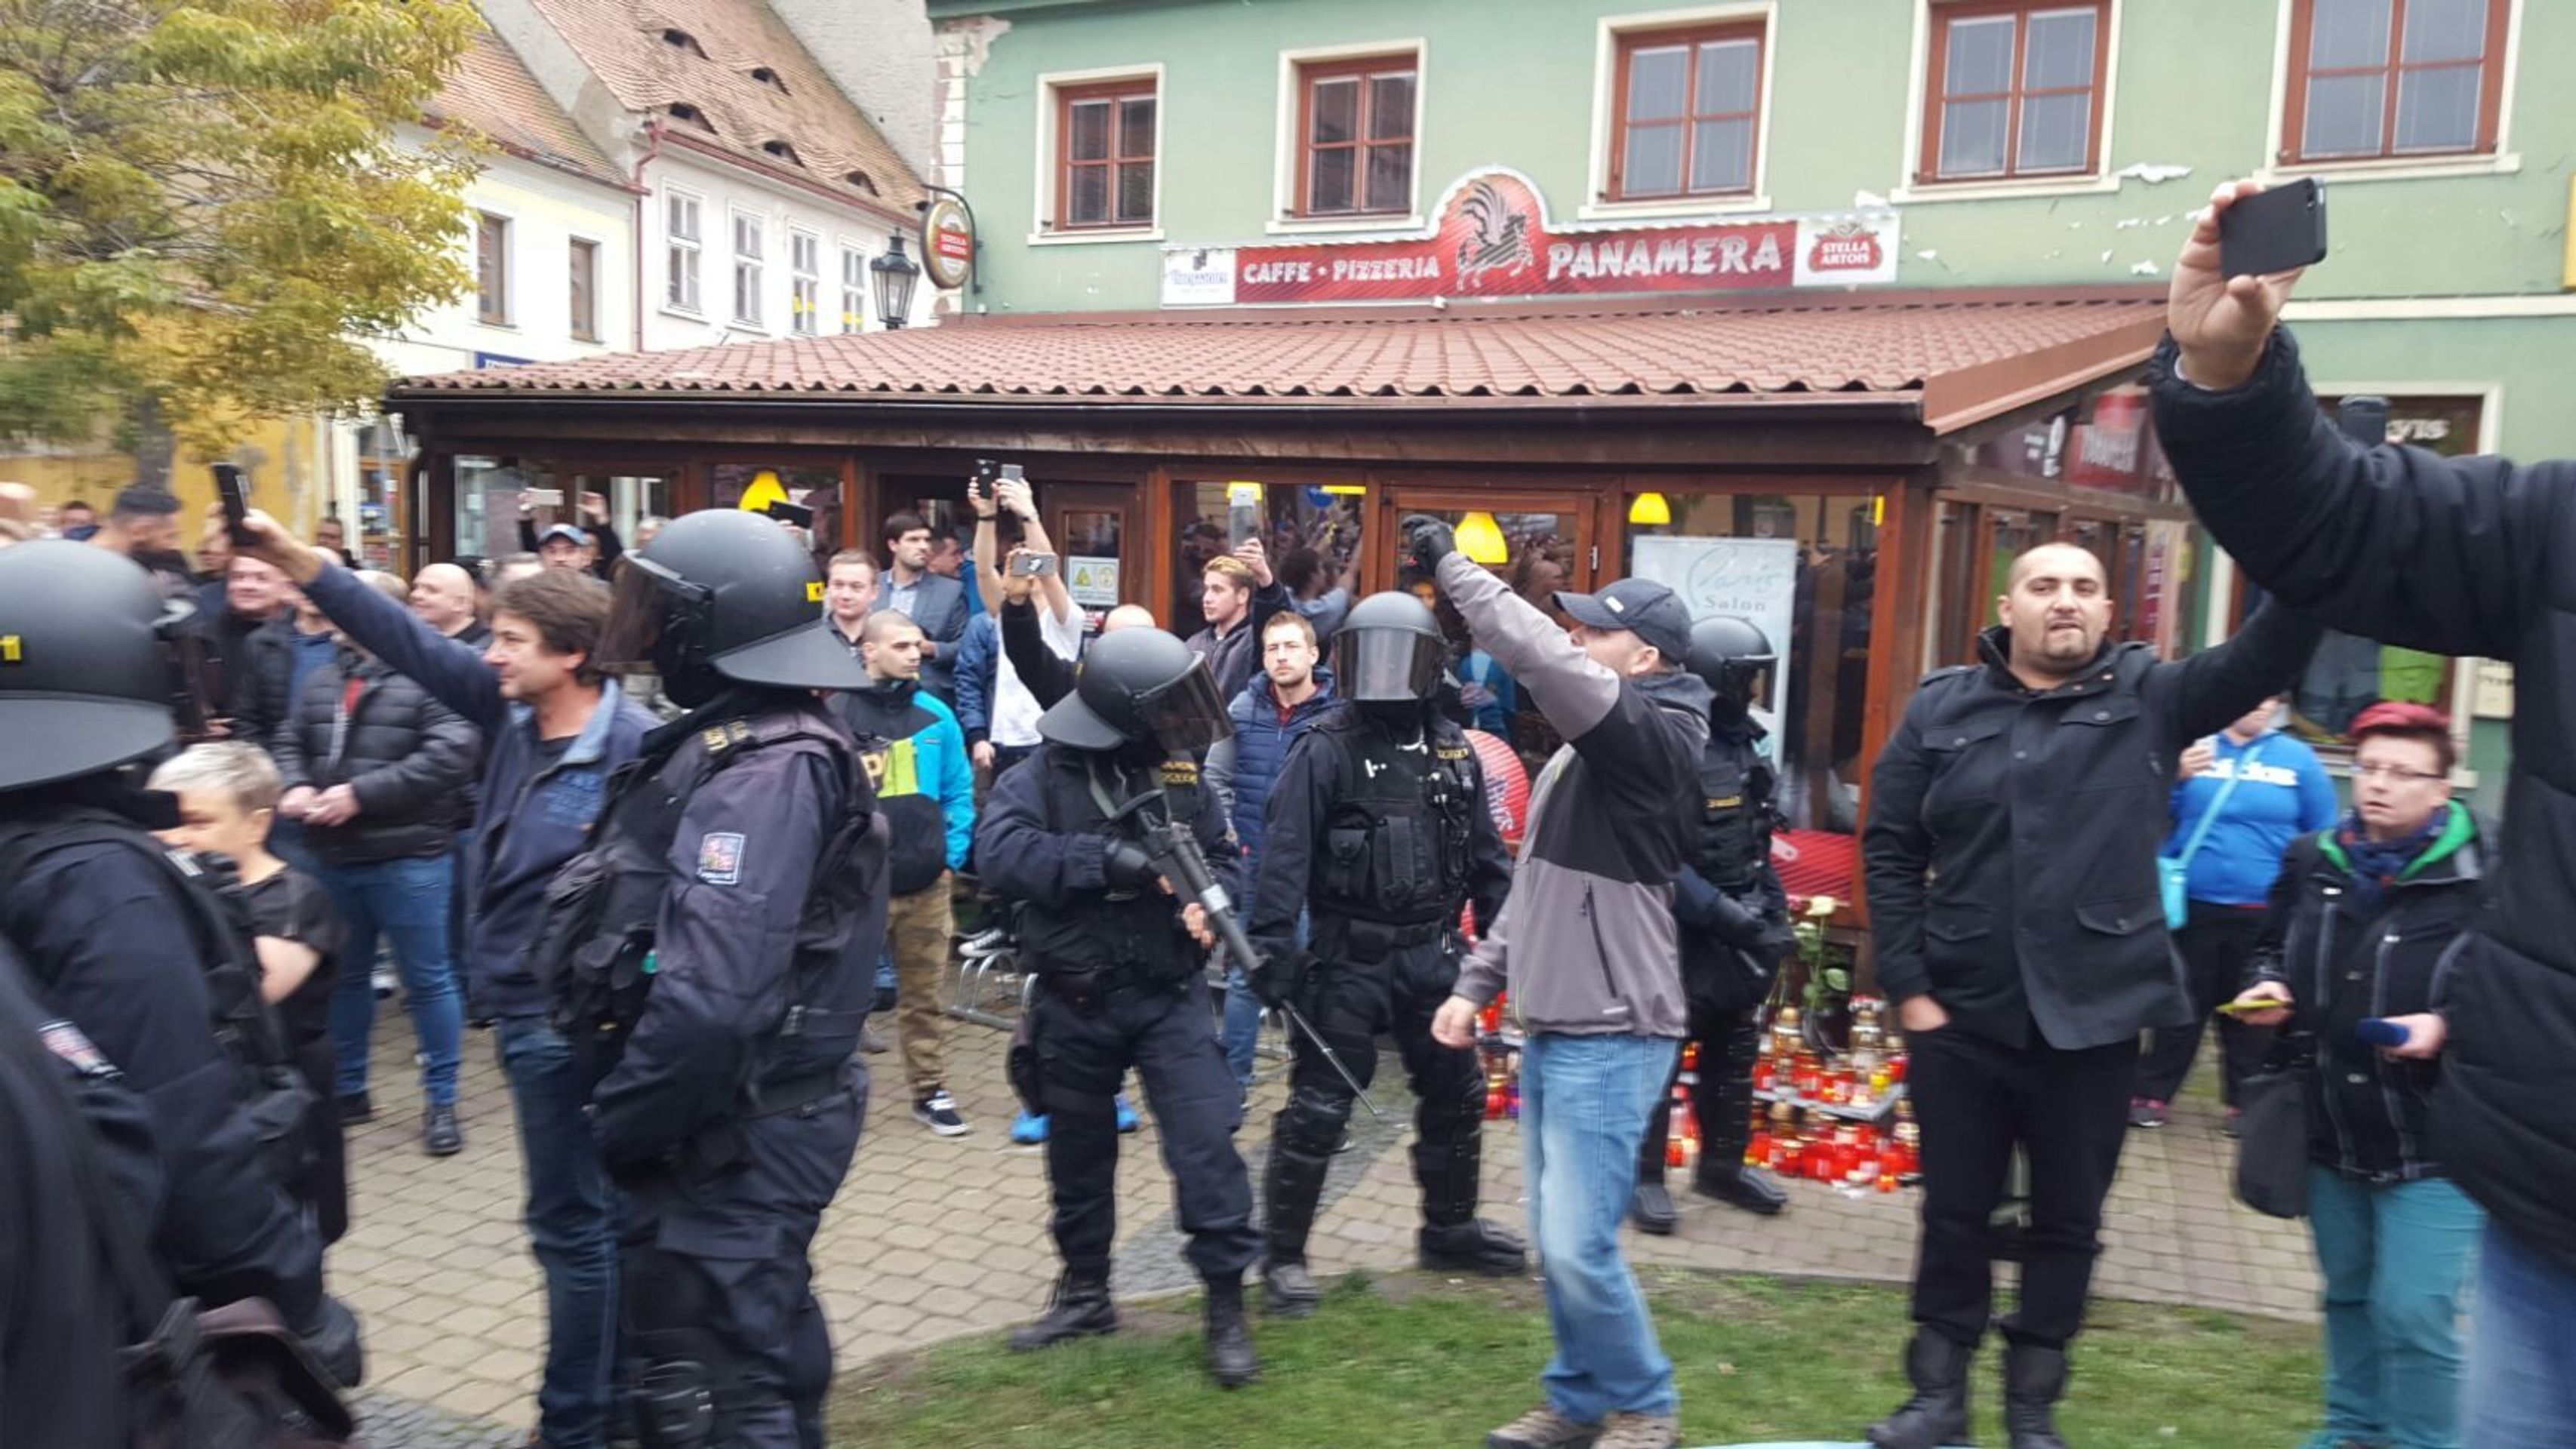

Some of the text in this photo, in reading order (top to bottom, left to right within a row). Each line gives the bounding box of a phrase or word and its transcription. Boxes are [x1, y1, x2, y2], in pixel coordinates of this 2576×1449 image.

[1821, 242, 1870, 254] STELLA
[1244, 262, 1312, 283] CAFFE
[1332, 257, 1440, 281] PIZZERIA
[1547, 233, 1783, 280] PANAMERA
[1820, 253, 1870, 266] ARTOIS
[1704, 595, 1766, 612] Salon
